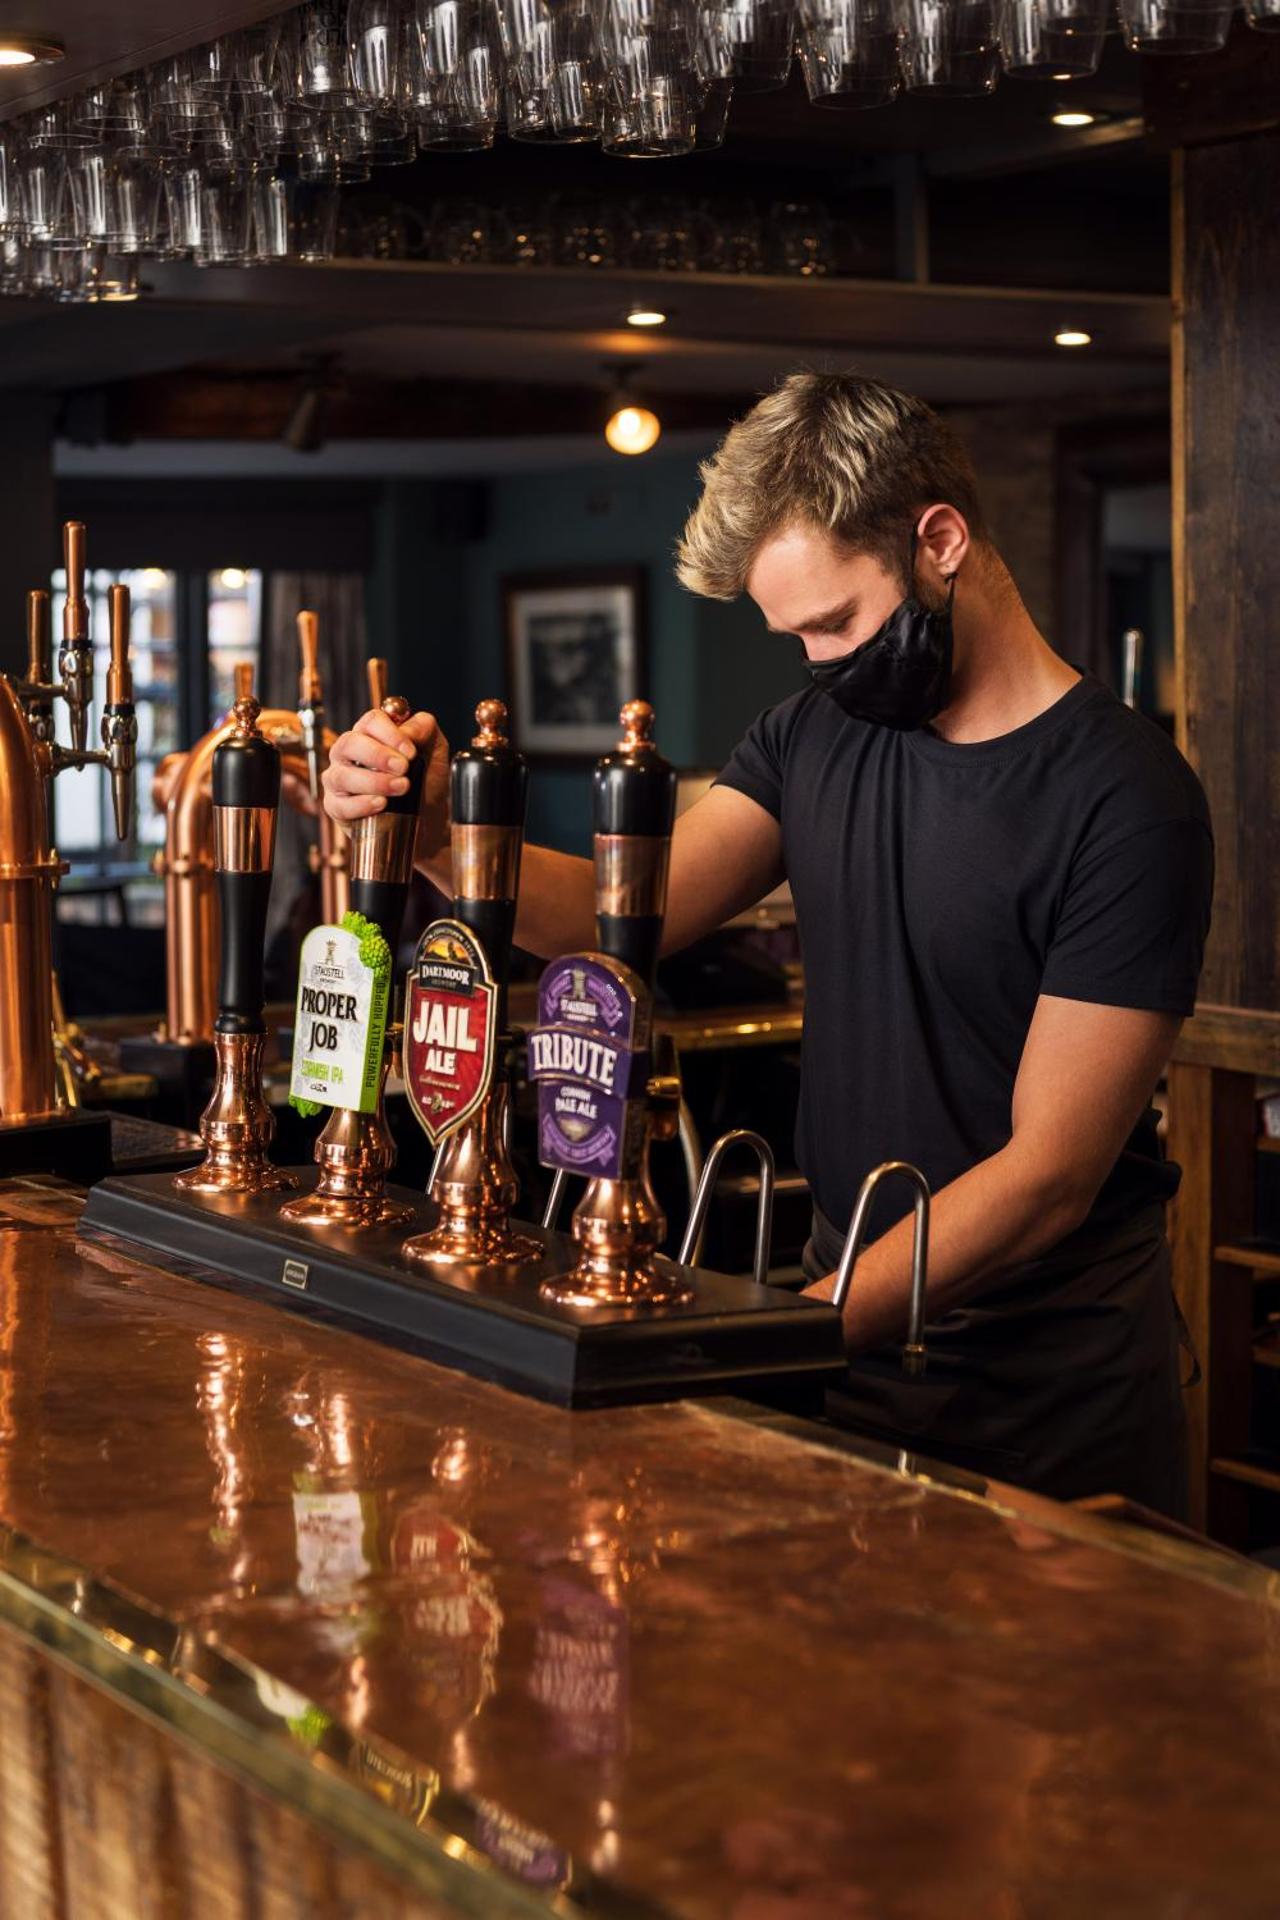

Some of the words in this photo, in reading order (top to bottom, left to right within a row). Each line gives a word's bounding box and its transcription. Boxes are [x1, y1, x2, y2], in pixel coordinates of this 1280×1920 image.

[422, 965, 469, 985] DARTMOOR
[301, 986, 358, 1021] PROPER
[373, 982, 386, 1020] HOPPED
[309, 1022, 338, 1052] JOB
[413, 1000, 477, 1052] JAIL
[365, 1023, 382, 1088] POWERFULLY
[425, 1048, 456, 1076] ALE
[531, 1033, 618, 1088] TRIBUTE
[555, 1097, 577, 1113] PALE
[577, 1101, 598, 1119] ALE
